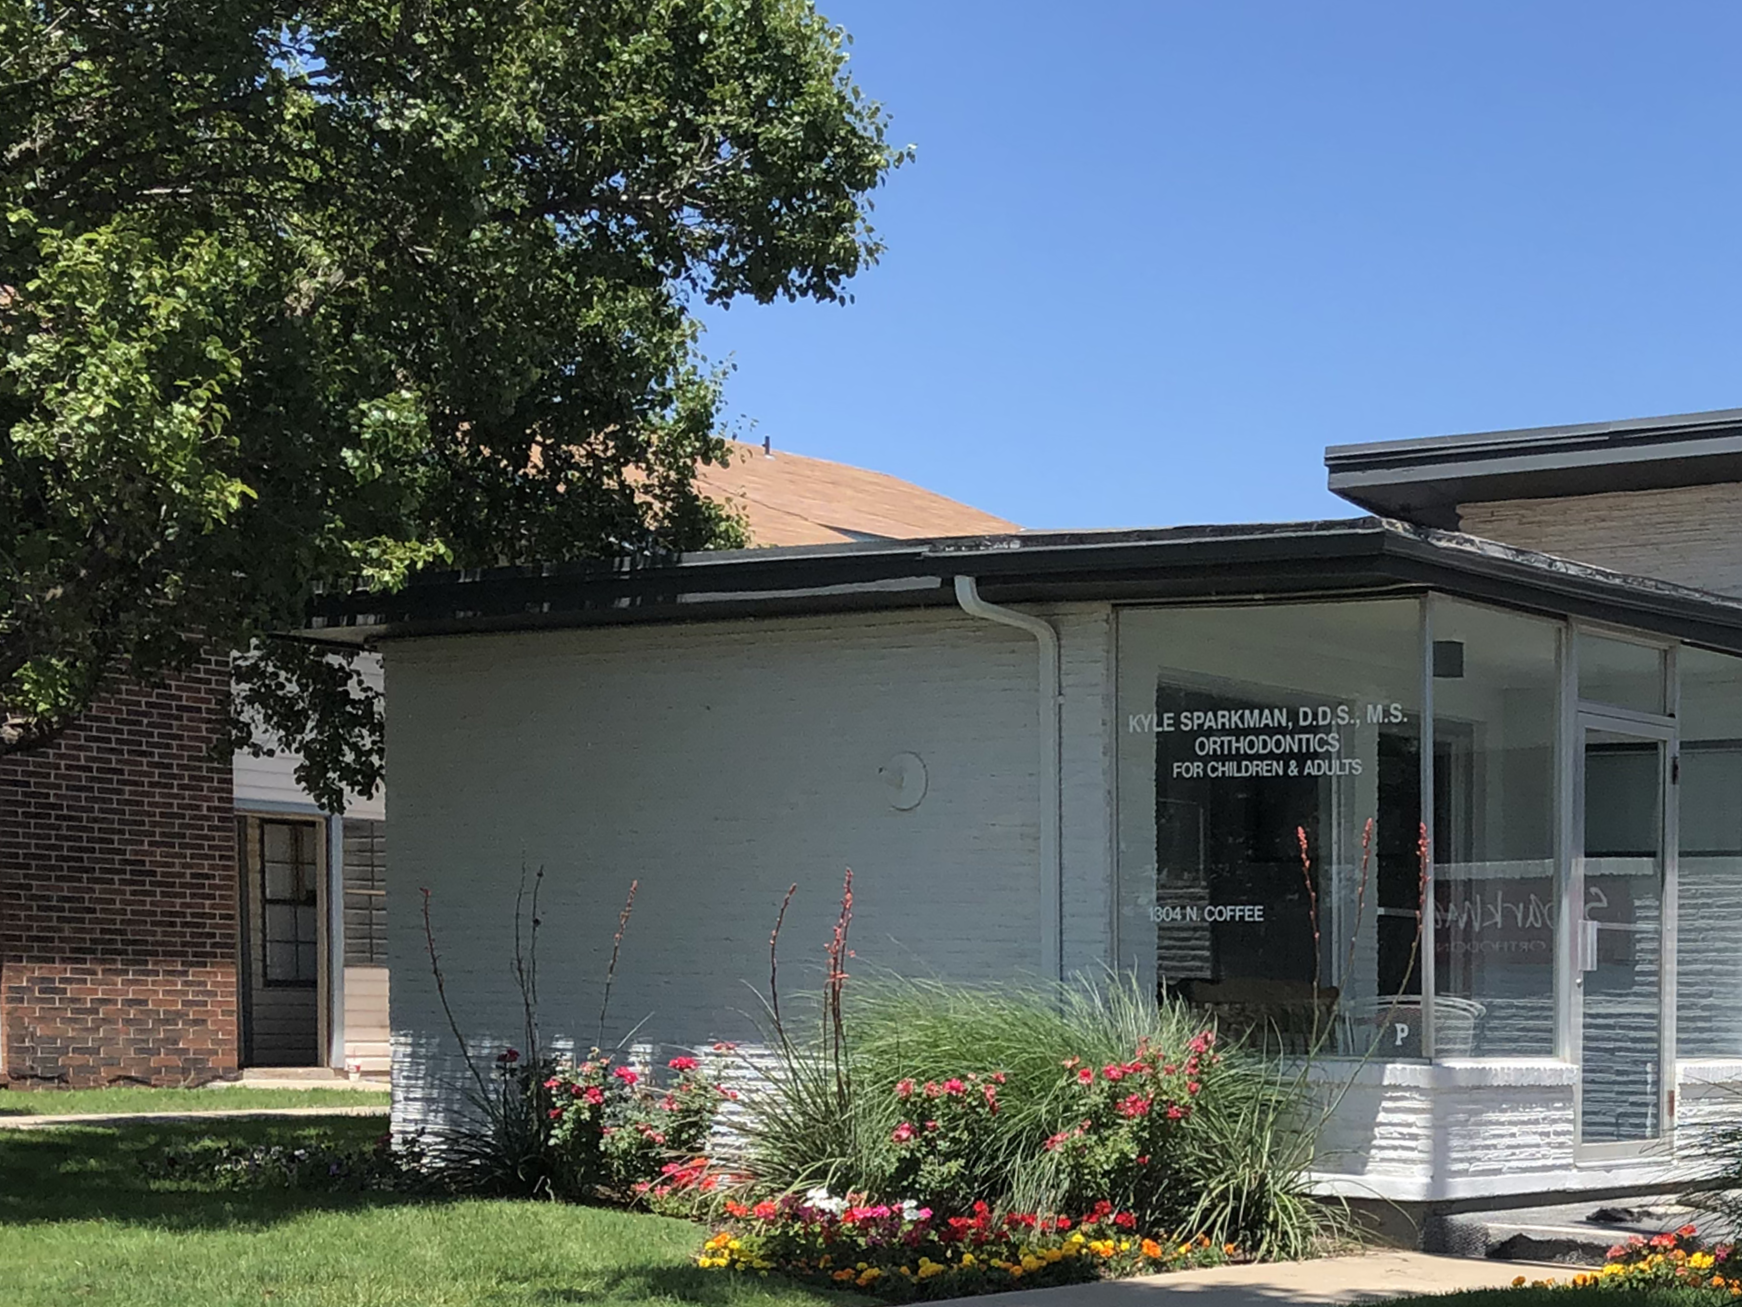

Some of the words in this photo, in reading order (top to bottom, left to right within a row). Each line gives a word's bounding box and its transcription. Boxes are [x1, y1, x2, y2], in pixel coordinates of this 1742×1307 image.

[1128, 711, 1175, 733] KYLE
[1180, 707, 1293, 731] SPARKMAN,
[1299, 704, 1360, 728] D.D.S.,
[1367, 703, 1408, 724] M.S.
[1195, 733, 1340, 756] ORTHODONTICS
[1173, 761, 1203, 778] FOR
[1207, 760, 1283, 778] CHILDREN
[1288, 760, 1299, 777] &
[1303, 758, 1362, 777] ADULTS
[1150, 906, 1182, 922] 1304
[1186, 906, 1200, 922] N.
[1204, 905, 1264, 922] COFFEE
[1394, 1023, 1409, 1046] P
